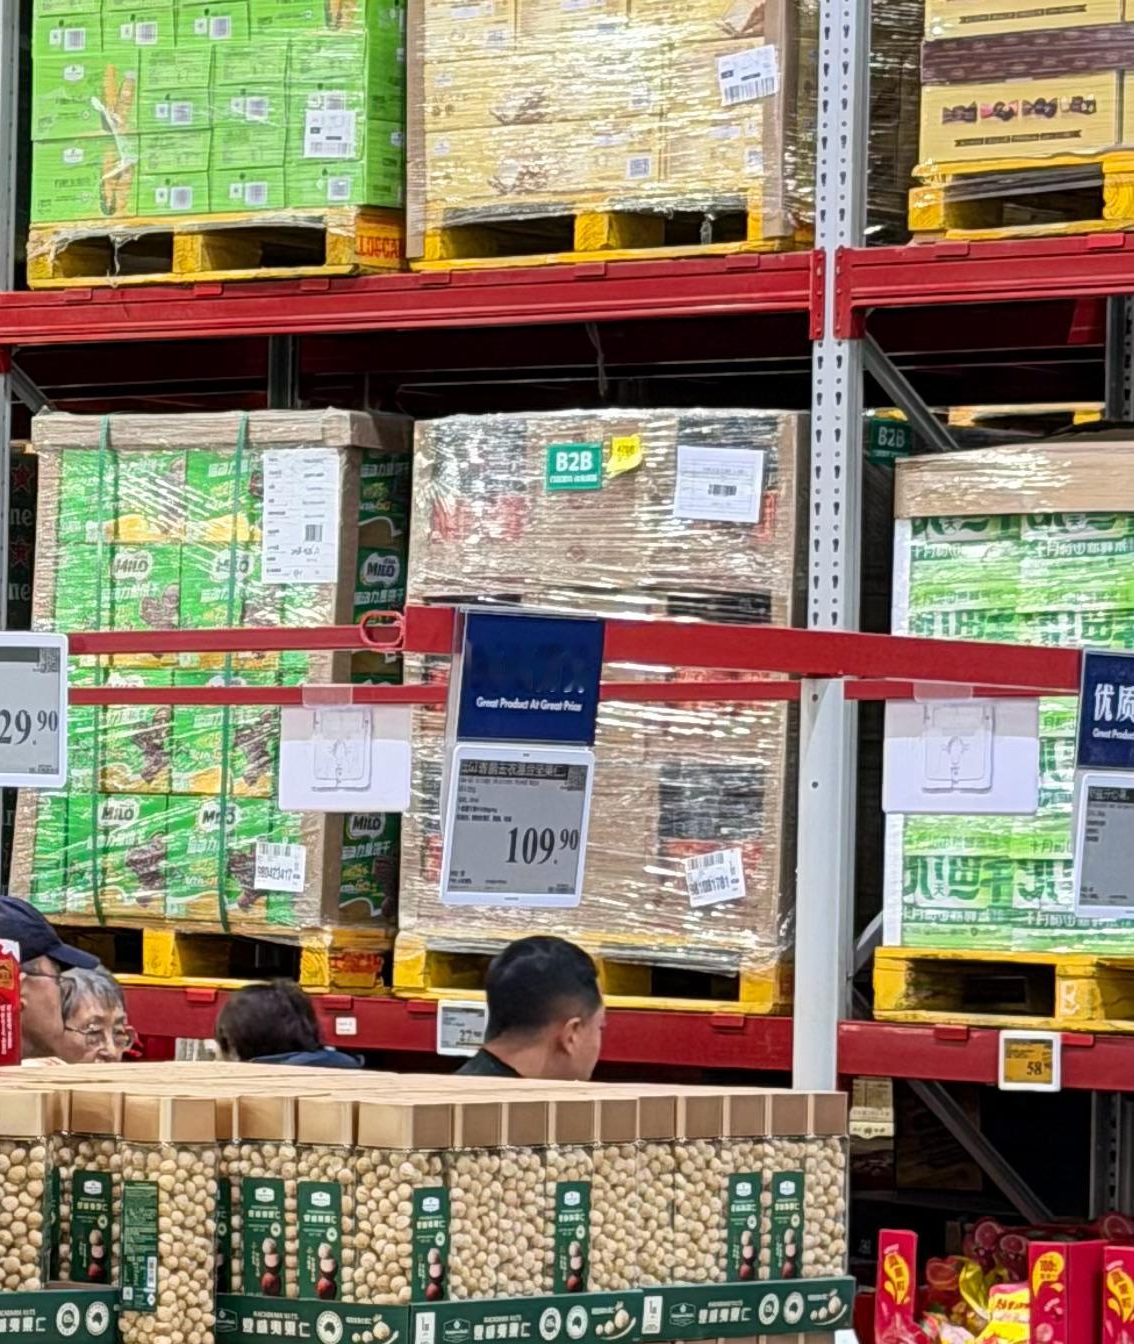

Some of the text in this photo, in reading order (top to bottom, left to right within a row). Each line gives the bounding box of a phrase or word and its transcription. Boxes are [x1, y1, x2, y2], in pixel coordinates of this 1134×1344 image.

[556, 452, 593, 472] B2B
[366, 562, 396, 578] MILO
[476, 696, 499, 708] Great
[500, 698, 528, 710] Product
[540, 700, 562, 711] Great
[351, 816, 382, 832] MILO
